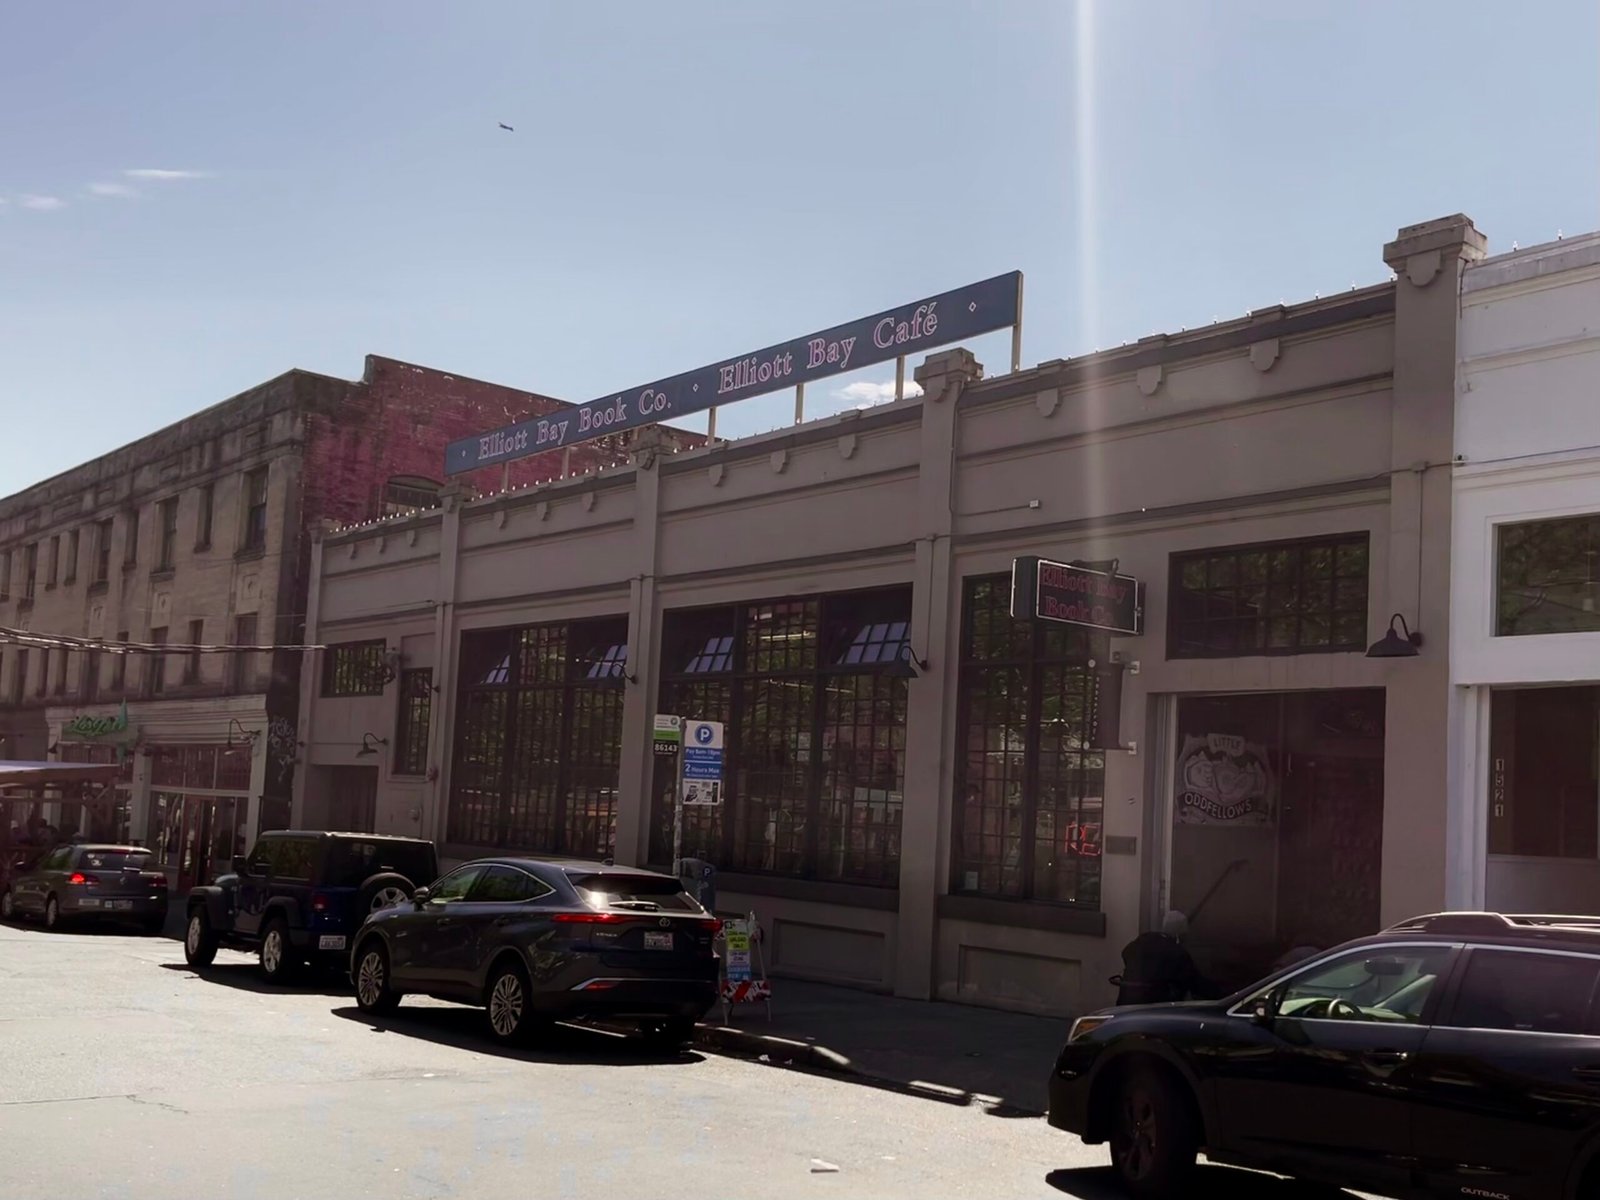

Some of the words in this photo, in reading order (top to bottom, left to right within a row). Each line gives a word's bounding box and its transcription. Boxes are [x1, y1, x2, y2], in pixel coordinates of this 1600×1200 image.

[478, 429, 528, 460] Elliott
[536, 420, 569, 445] Bay
[578, 397, 627, 433] Book
[638, 389, 673, 416] Co.
[718, 352, 793, 394] Elliott
[806, 337, 857, 370] Bay
[873, 302, 938, 349] Café
[1041, 567, 1092, 593] Elliott
[1045, 595, 1089, 620] Book
[654, 743, 677, 752] 86143
[700, 728, 711, 742] P
[684, 763, 691, 773] 2
[1495, 759, 1504, 817] 1521
[1183, 791, 1253, 818] ODDFELLOWS
[1460, 1185, 1511, 1200] OUTBACK
